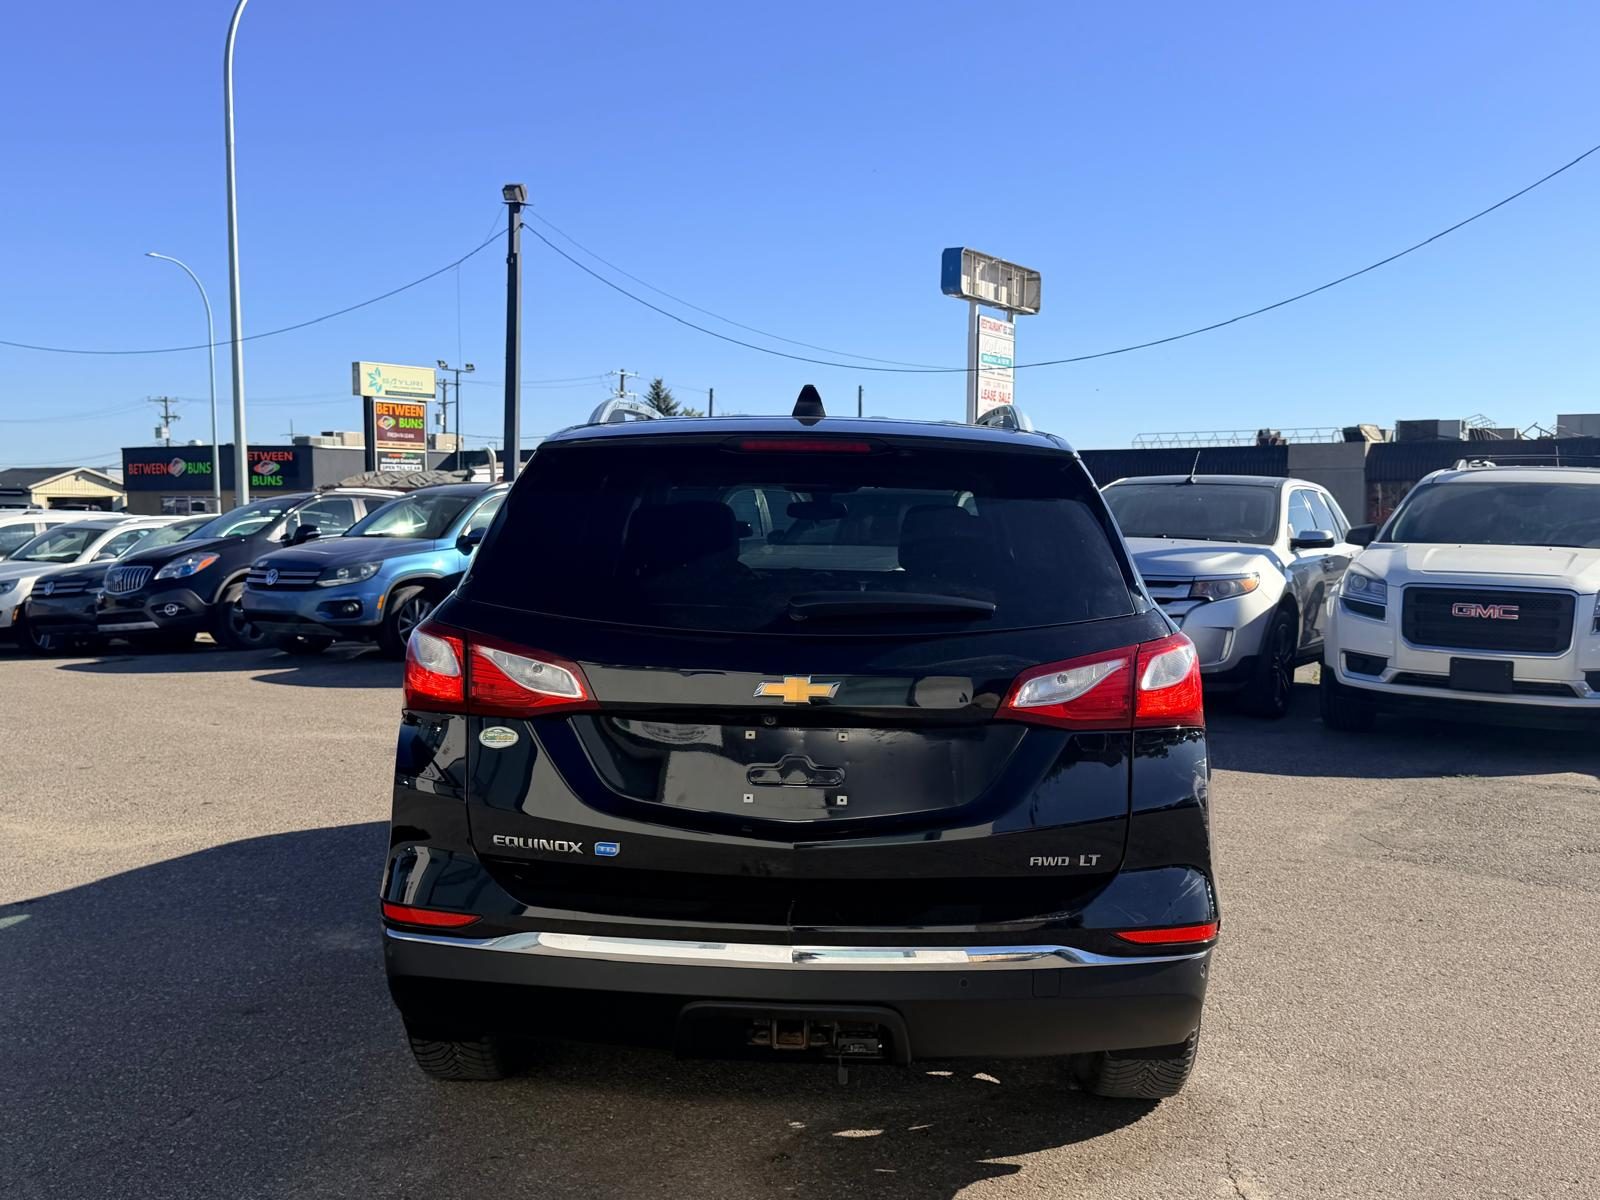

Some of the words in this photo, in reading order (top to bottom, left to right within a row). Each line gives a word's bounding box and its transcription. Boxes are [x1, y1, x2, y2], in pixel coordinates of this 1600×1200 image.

[376, 403, 424, 417] BETWEEN
[399, 417, 424, 429] BUNS
[247, 451, 293, 461] ETWEEN
[128, 463, 167, 475] BETWEEN
[187, 462, 212, 474] BUNS
[251, 476, 283, 486] BUNS
[1452, 602, 1520, 620] GMC
[493, 834, 583, 854] EQUINOX
[1029, 856, 1070, 866] AWD
[1079, 854, 1101, 866] LT
